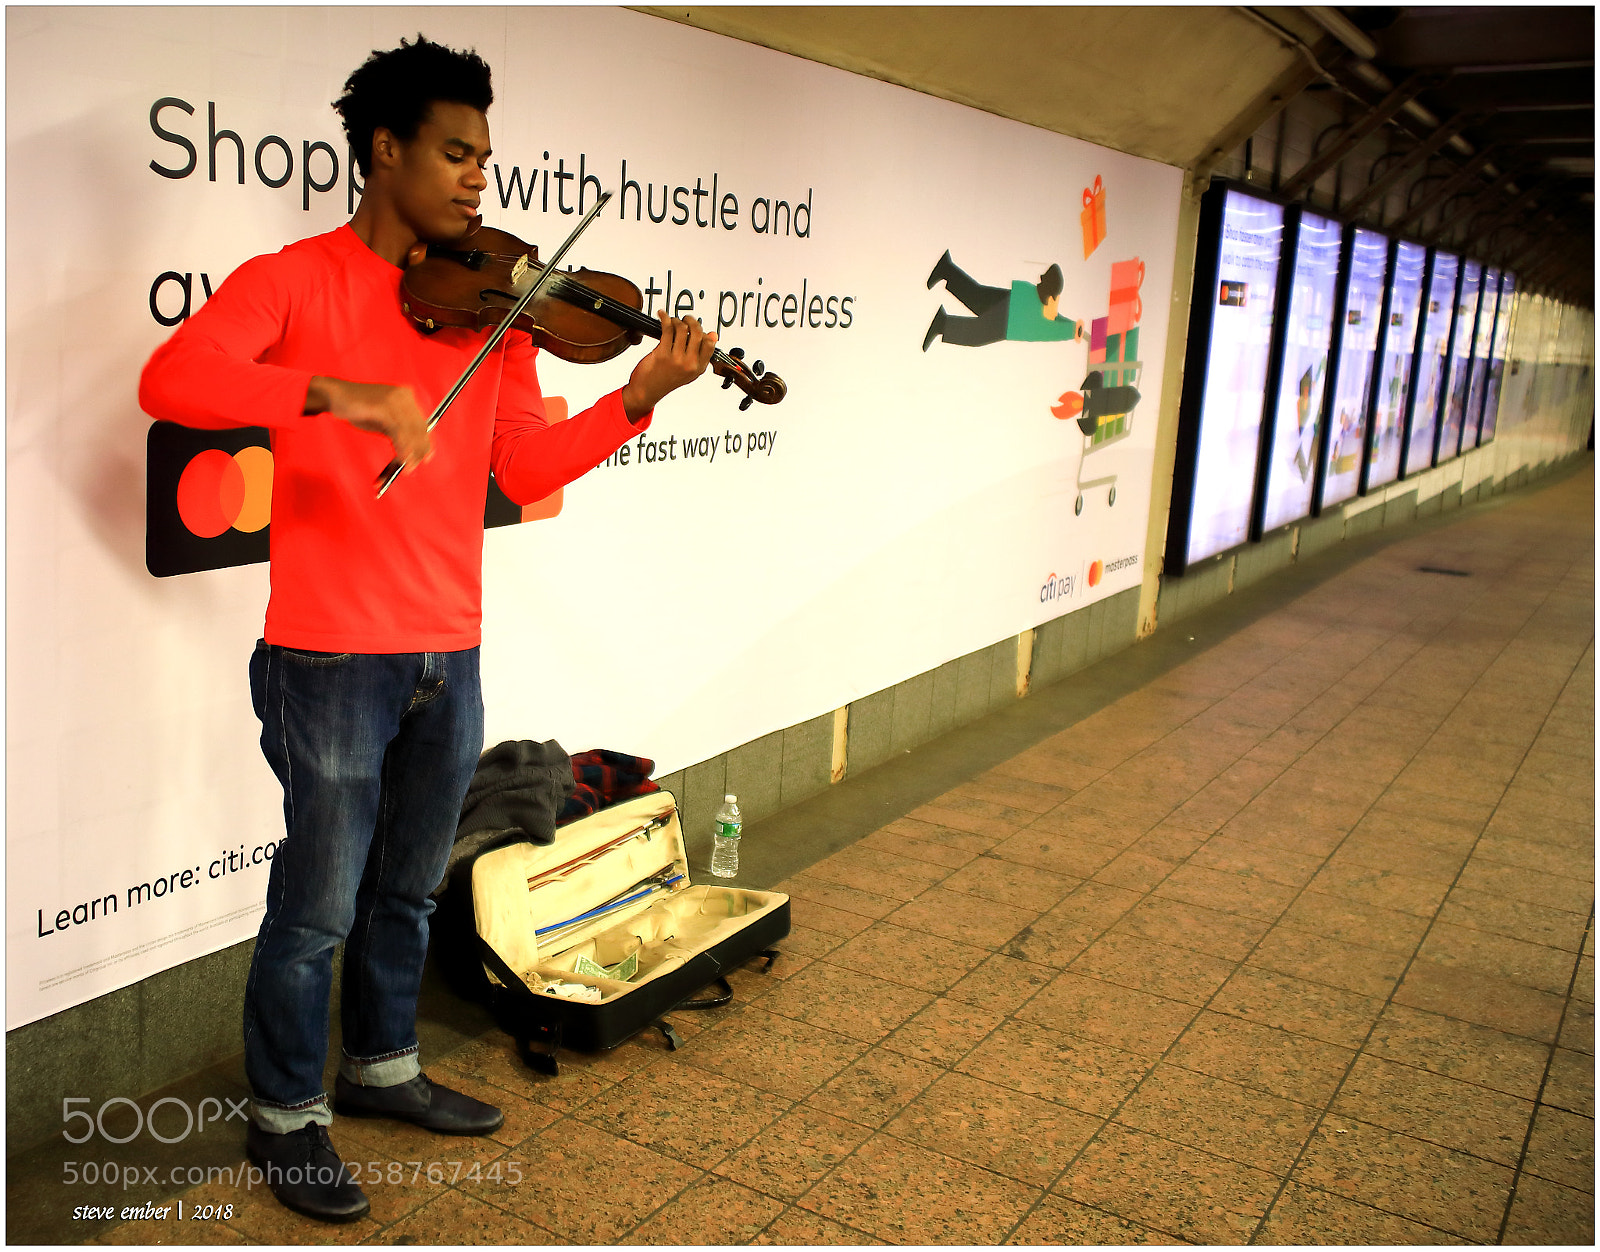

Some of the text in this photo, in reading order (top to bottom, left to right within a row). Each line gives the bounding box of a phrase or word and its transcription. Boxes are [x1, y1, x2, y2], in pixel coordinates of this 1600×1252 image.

[149, 96, 813, 238] Shopp with hustle and
[716, 277, 854, 341] priceless
[636, 432, 678, 464] fast
[682, 435, 720, 463] way
[724, 429, 742, 454] to
[746, 430, 777, 459] pay
[1040, 573, 1077, 604] citi pay
[1104, 554, 1139, 574] masterpass
[37, 838, 283, 939] Learn more: citi.co
